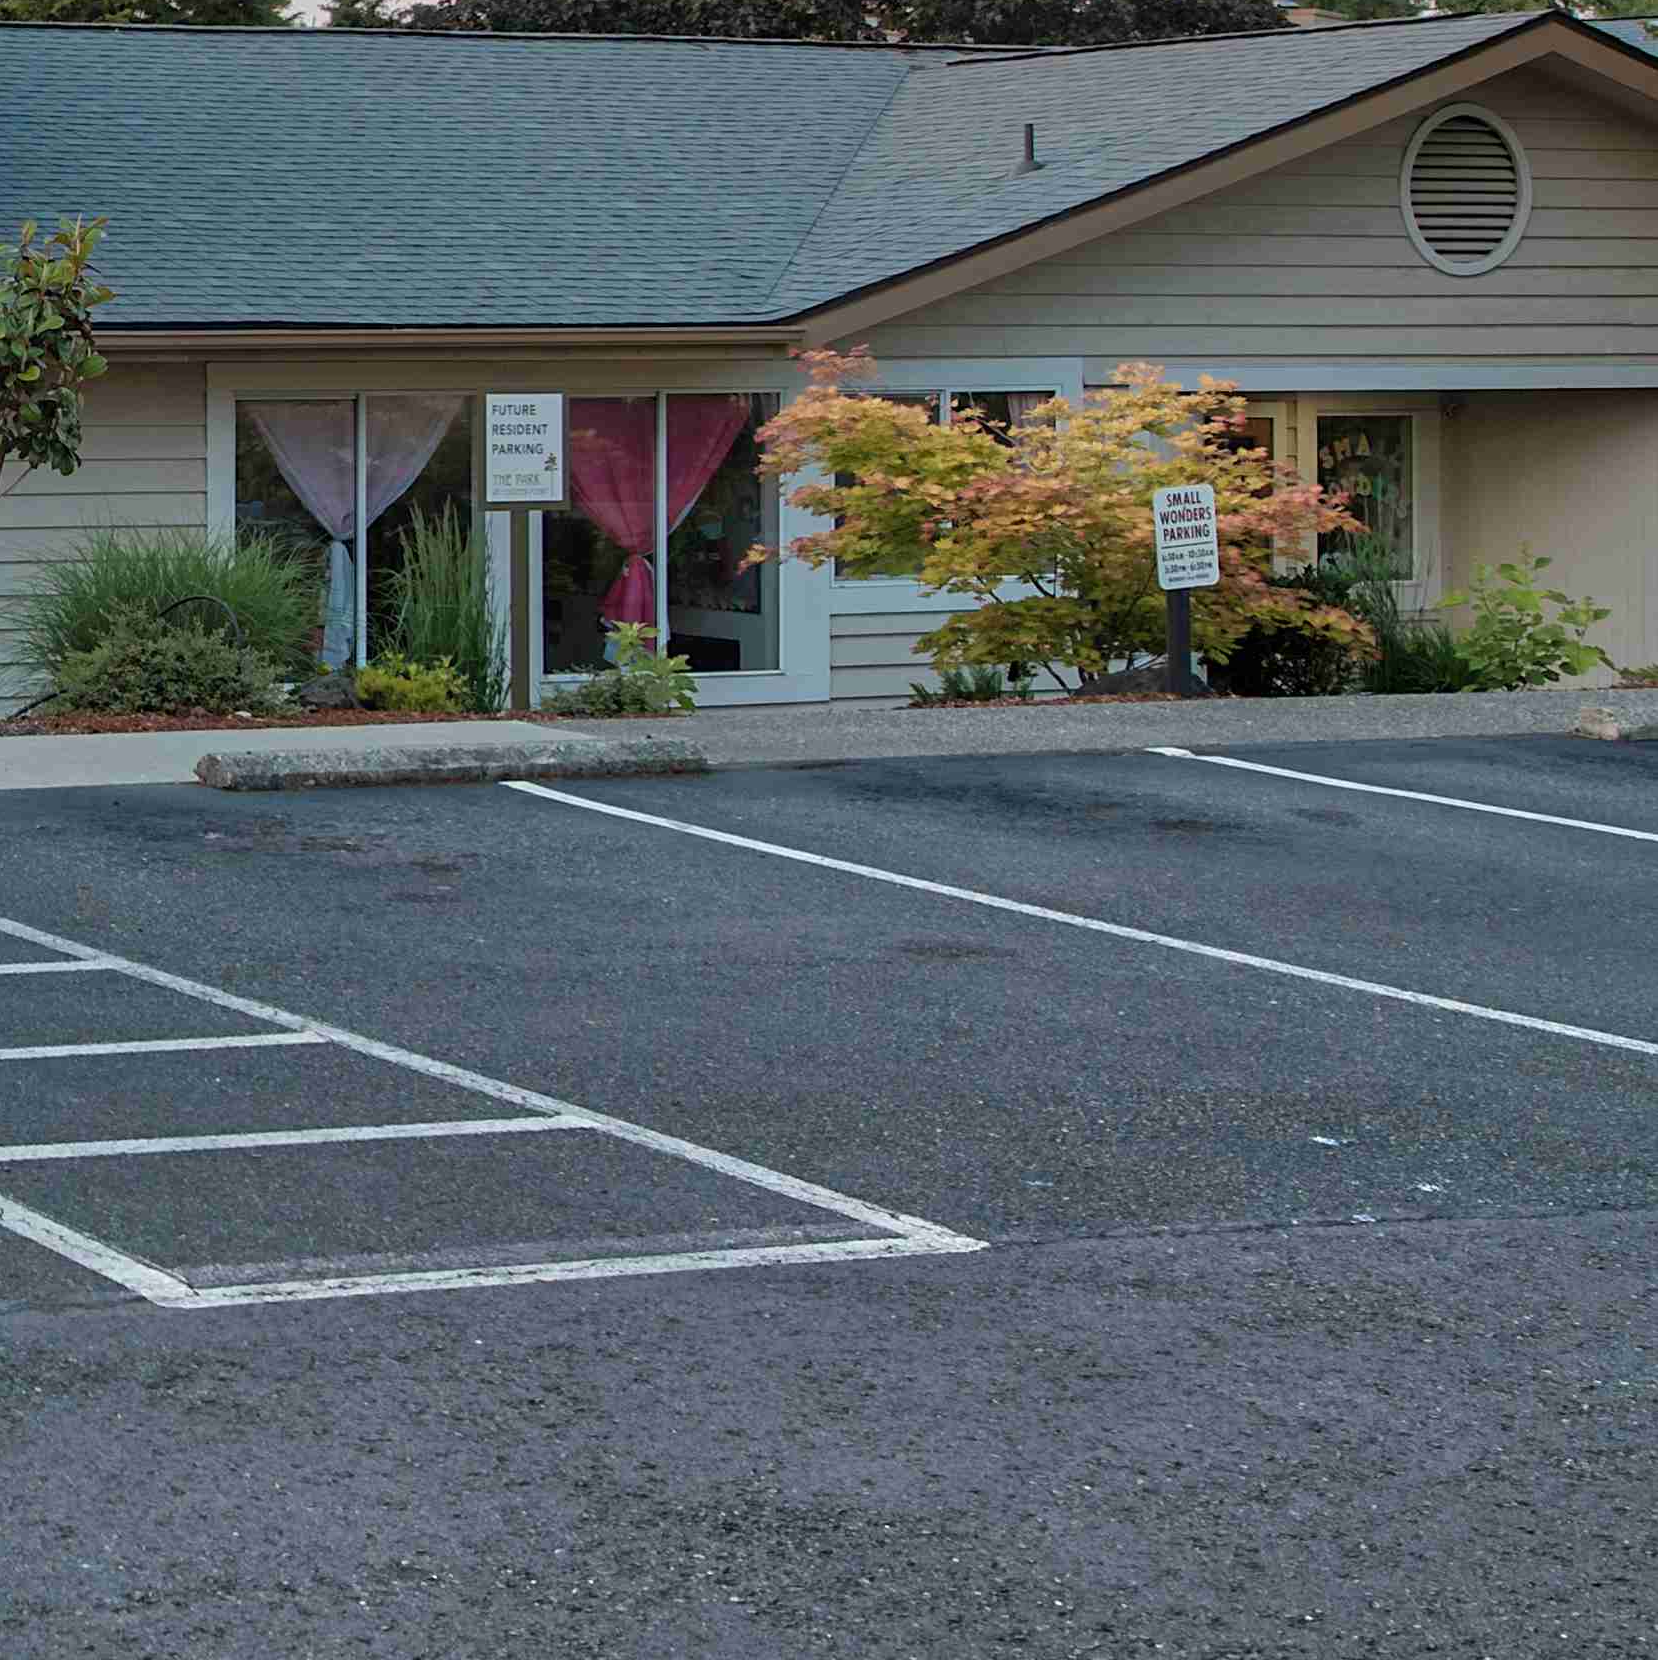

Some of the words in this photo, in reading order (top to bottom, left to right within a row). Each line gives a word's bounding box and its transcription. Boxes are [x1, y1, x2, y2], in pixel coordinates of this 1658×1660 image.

[492, 404, 537, 416] FUTURE
[492, 423, 548, 436] RESIDENT
[492, 443, 544, 455] PARKING
[1166, 491, 1202, 507] SMALL
[1160, 506, 1212, 525] WONDERS
[1163, 524, 1210, 541] PARKING
